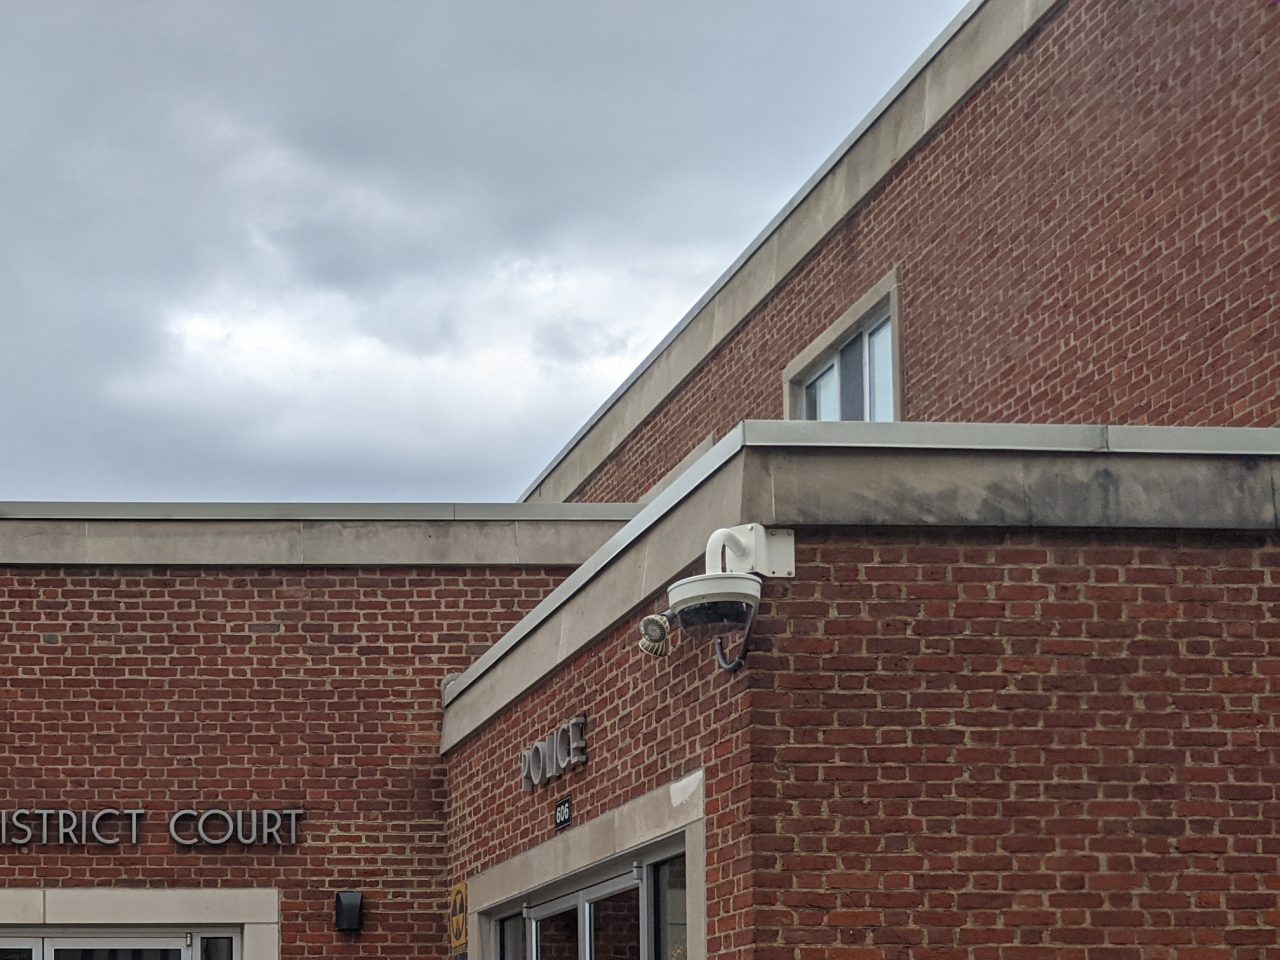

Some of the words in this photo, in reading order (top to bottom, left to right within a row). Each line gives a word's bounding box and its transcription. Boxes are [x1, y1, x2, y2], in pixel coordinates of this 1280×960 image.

[521, 716, 587, 791] POLICE
[169, 808, 305, 846] COURT
[556, 802, 569, 824] 606
